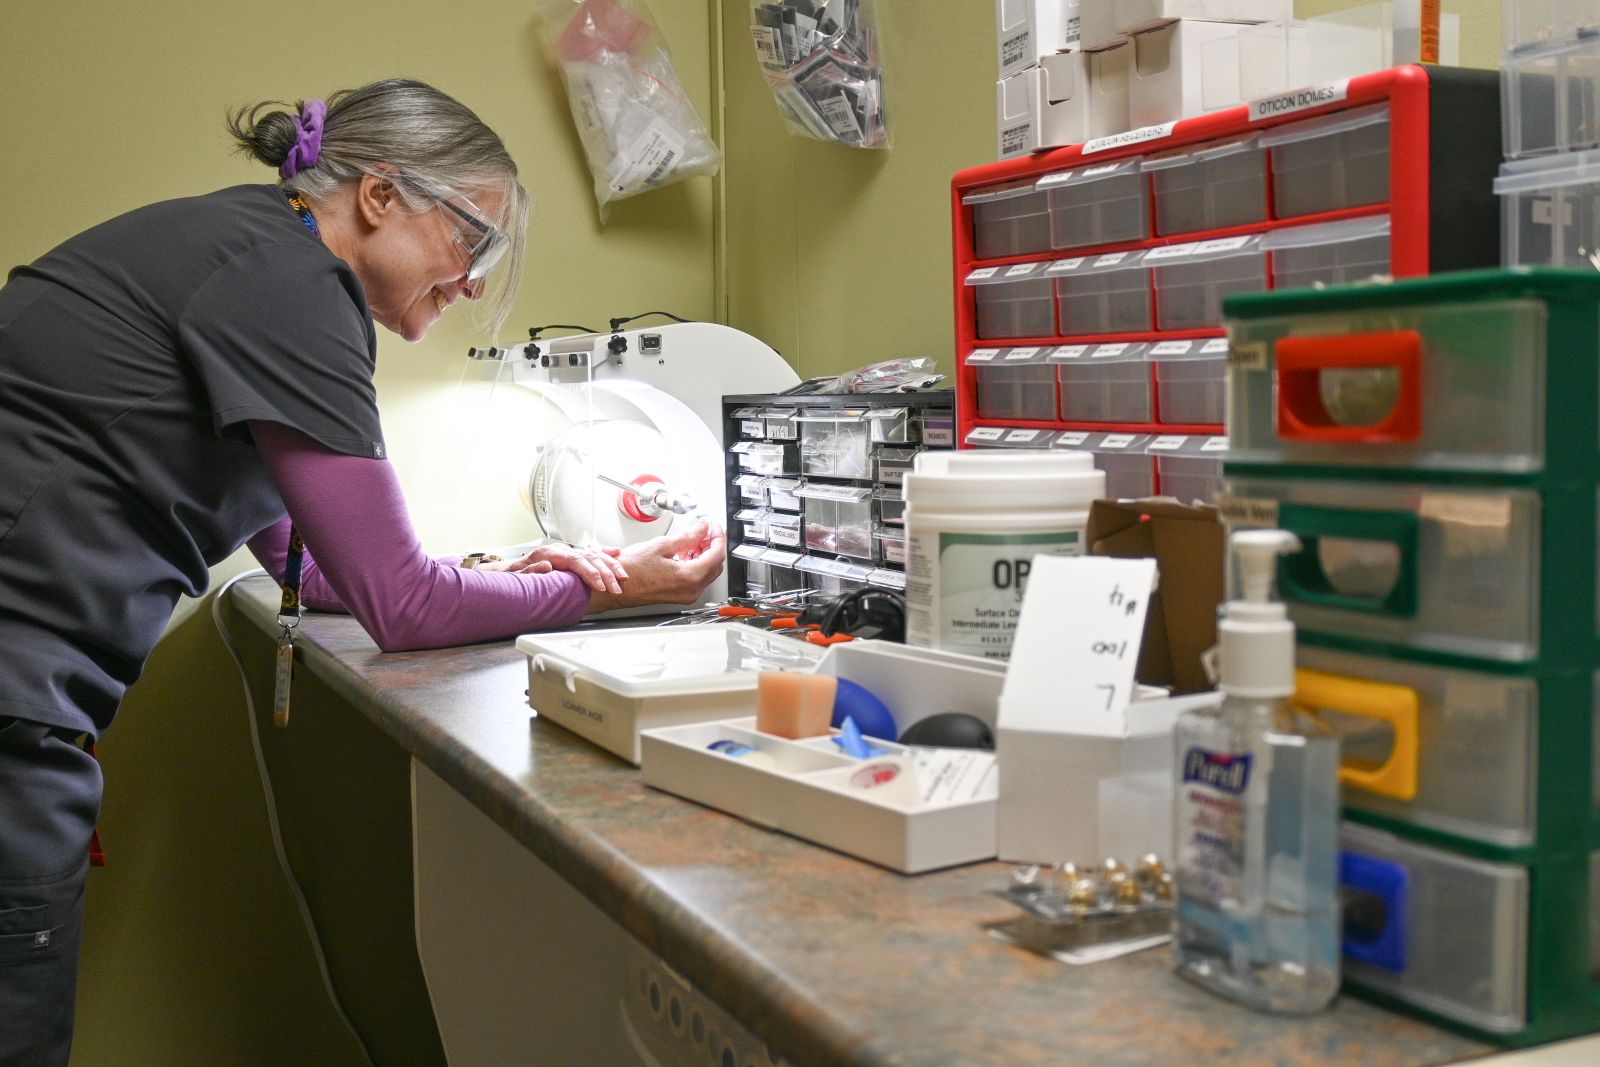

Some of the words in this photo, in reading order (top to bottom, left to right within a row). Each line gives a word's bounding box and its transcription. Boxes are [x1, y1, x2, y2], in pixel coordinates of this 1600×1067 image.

[1260, 96, 1295, 114] OTICON
[1298, 87, 1334, 105] DOMES
[975, 608, 1006, 618] Surface
[952, 619, 1000, 629] Intermediate
